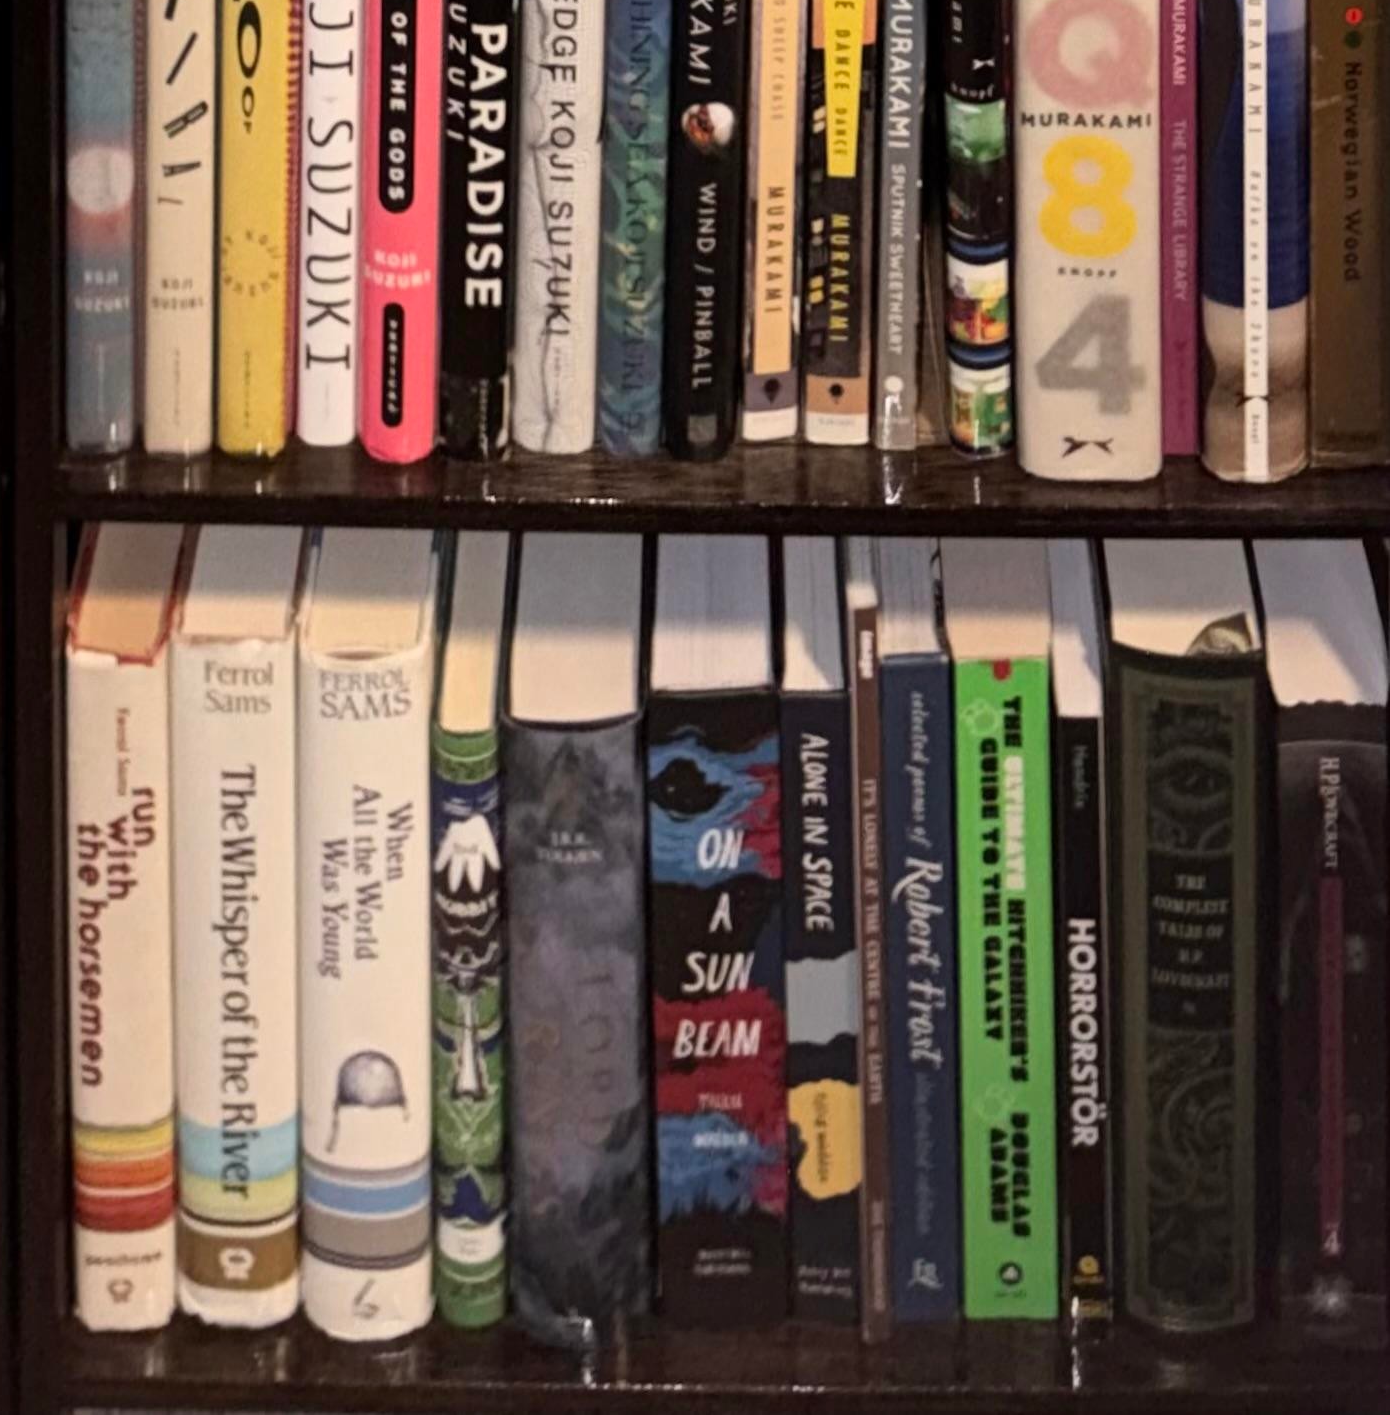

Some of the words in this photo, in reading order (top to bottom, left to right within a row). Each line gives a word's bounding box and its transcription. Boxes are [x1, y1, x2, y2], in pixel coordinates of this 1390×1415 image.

[1021, 114, 1151, 128] MURAKAMI
[465, 23, 508, 307] PARADISE
[1040, 136, 1136, 257] 8
[305, 120, 352, 369] SUZUKI
[1035, 294, 1144, 414] 4
[221, 765, 256, 832] The
[802, 735, 826, 807] ALONE
[132, 788, 156, 846] run
[698, 829, 744, 868] ON
[806, 817, 828, 849] IN
[79, 824, 101, 885] the
[108, 817, 135, 899] with
[213, 832, 256, 979] Whisper
[709, 891, 733, 933] A
[804, 852, 834, 932] SPACE
[78, 899, 104, 1087] horsemen
[222, 983, 254, 1024] of
[682, 952, 752, 991] SUN
[222, 1033, 254, 1094] the
[673, 1020, 760, 1059] BEAM
[220, 1099, 256, 1199] River
